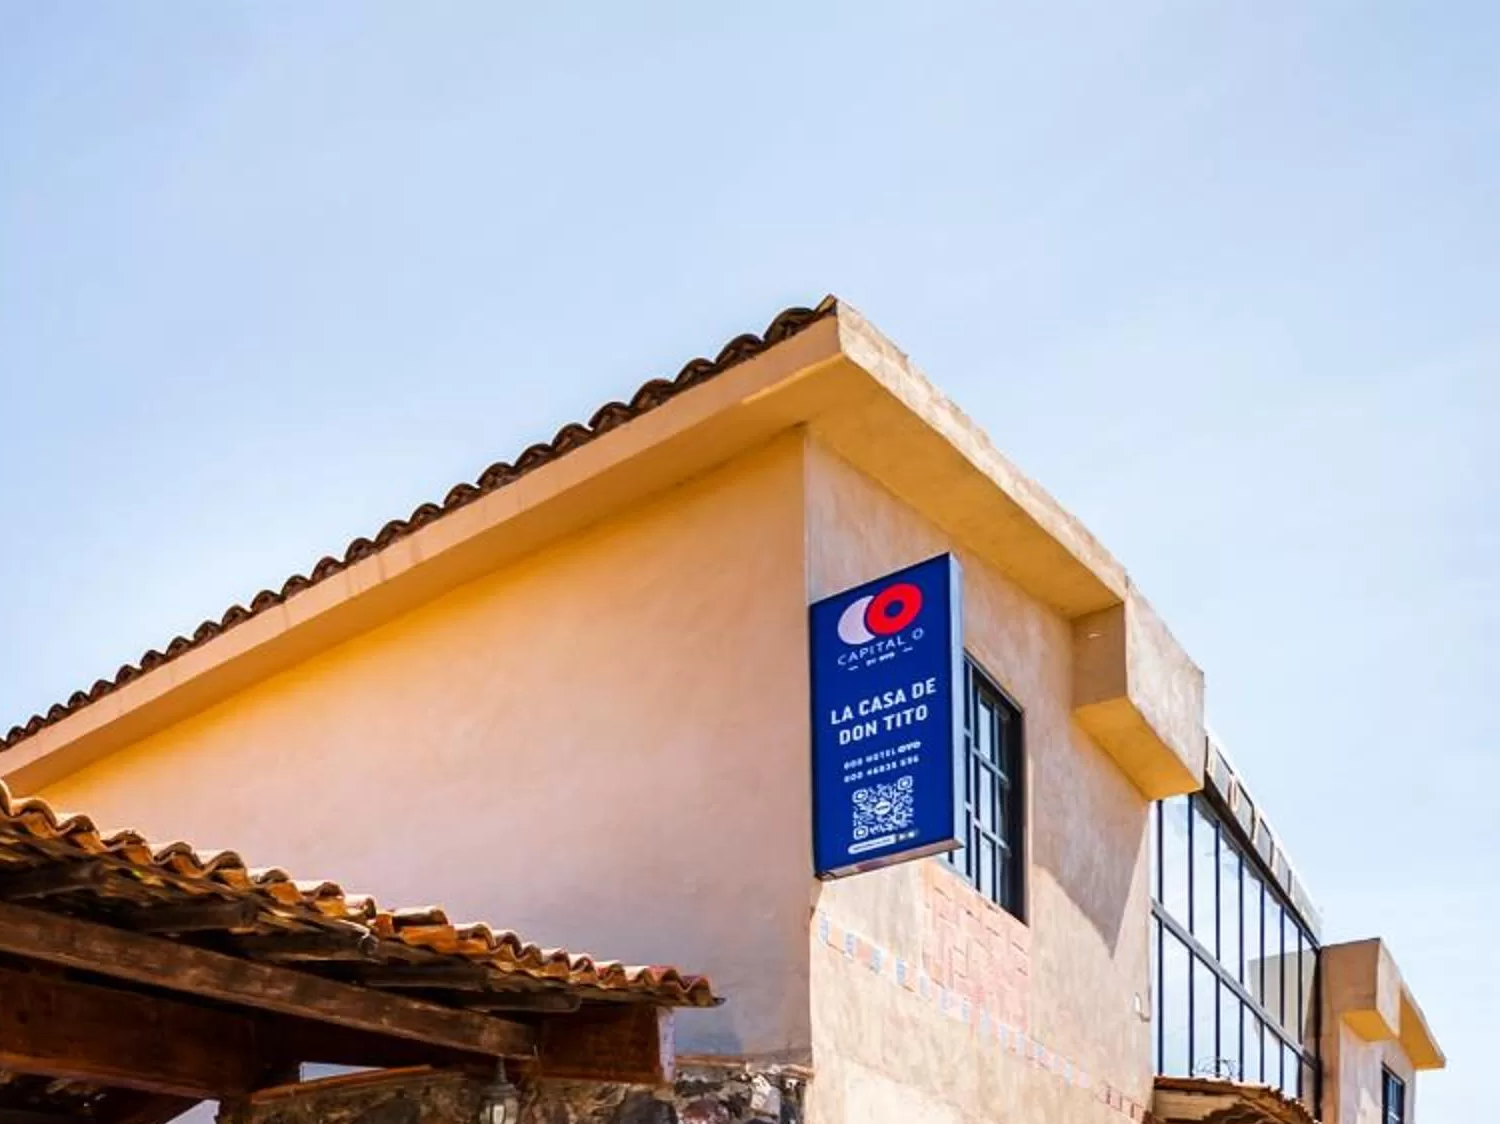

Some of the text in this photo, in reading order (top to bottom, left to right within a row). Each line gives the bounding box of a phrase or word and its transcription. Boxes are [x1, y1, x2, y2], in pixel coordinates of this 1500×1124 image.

[838, 635, 906, 665] CAPITAL
[911, 627, 924, 640] O
[831, 677, 937, 725] LA CASA DE
[839, 704, 928, 745] DON TITO
